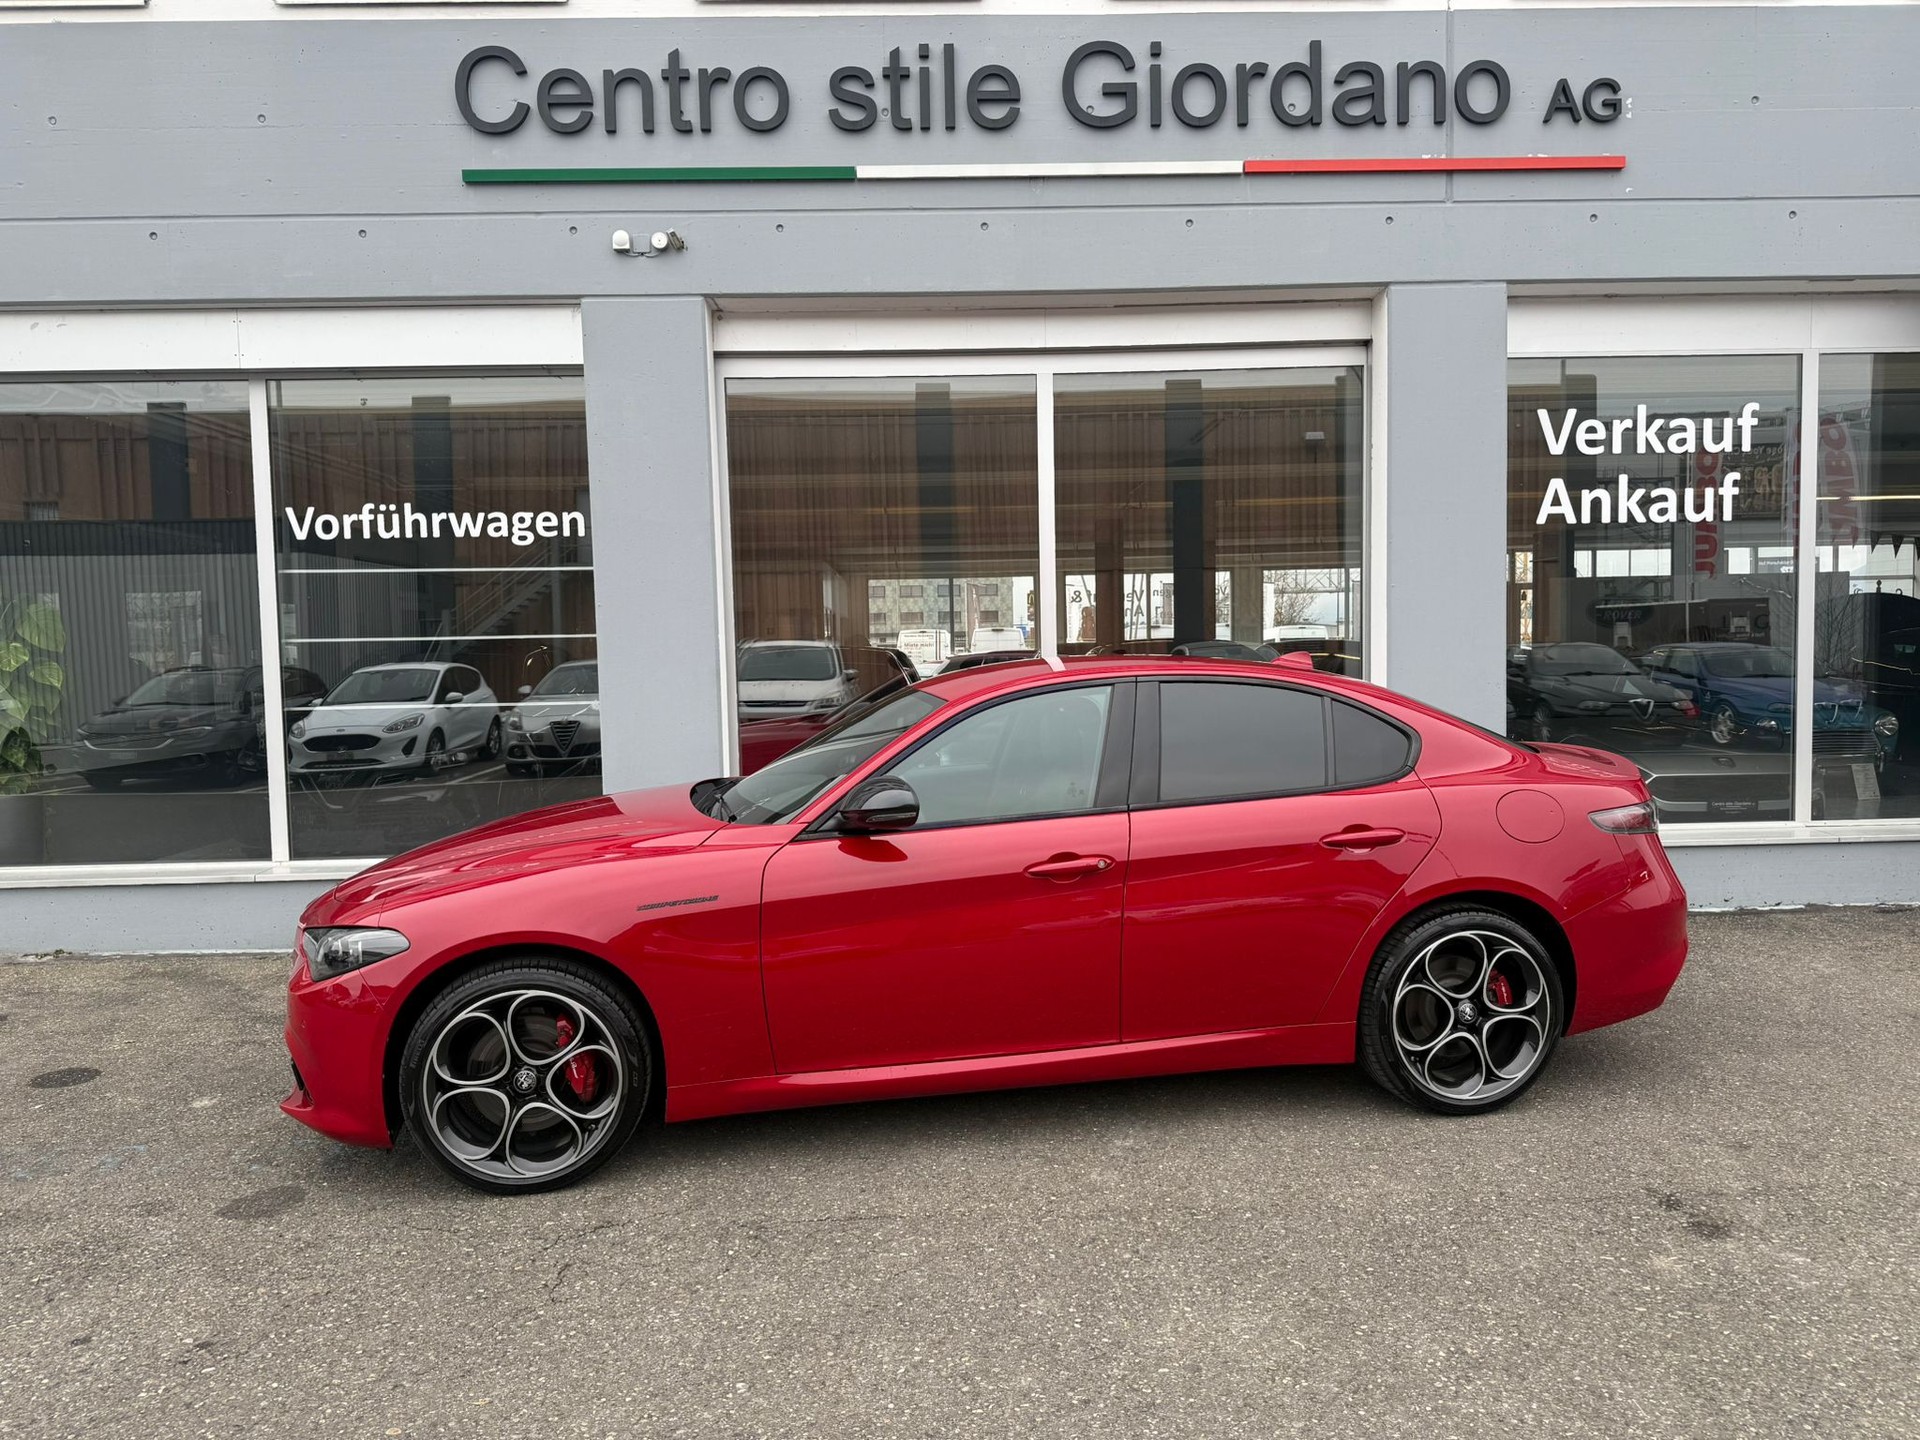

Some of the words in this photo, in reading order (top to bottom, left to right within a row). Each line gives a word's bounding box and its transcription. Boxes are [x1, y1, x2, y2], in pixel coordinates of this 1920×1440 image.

[455, 46, 789, 138] Centro
[829, 44, 1021, 135] stile
[1062, 40, 1510, 132] Giordano
[1543, 78, 1622, 125] AG
[1538, 402, 1759, 454] Verkauf
[286, 503, 585, 545] Vorführwagen
[1537, 472, 1740, 524] Ankauf
